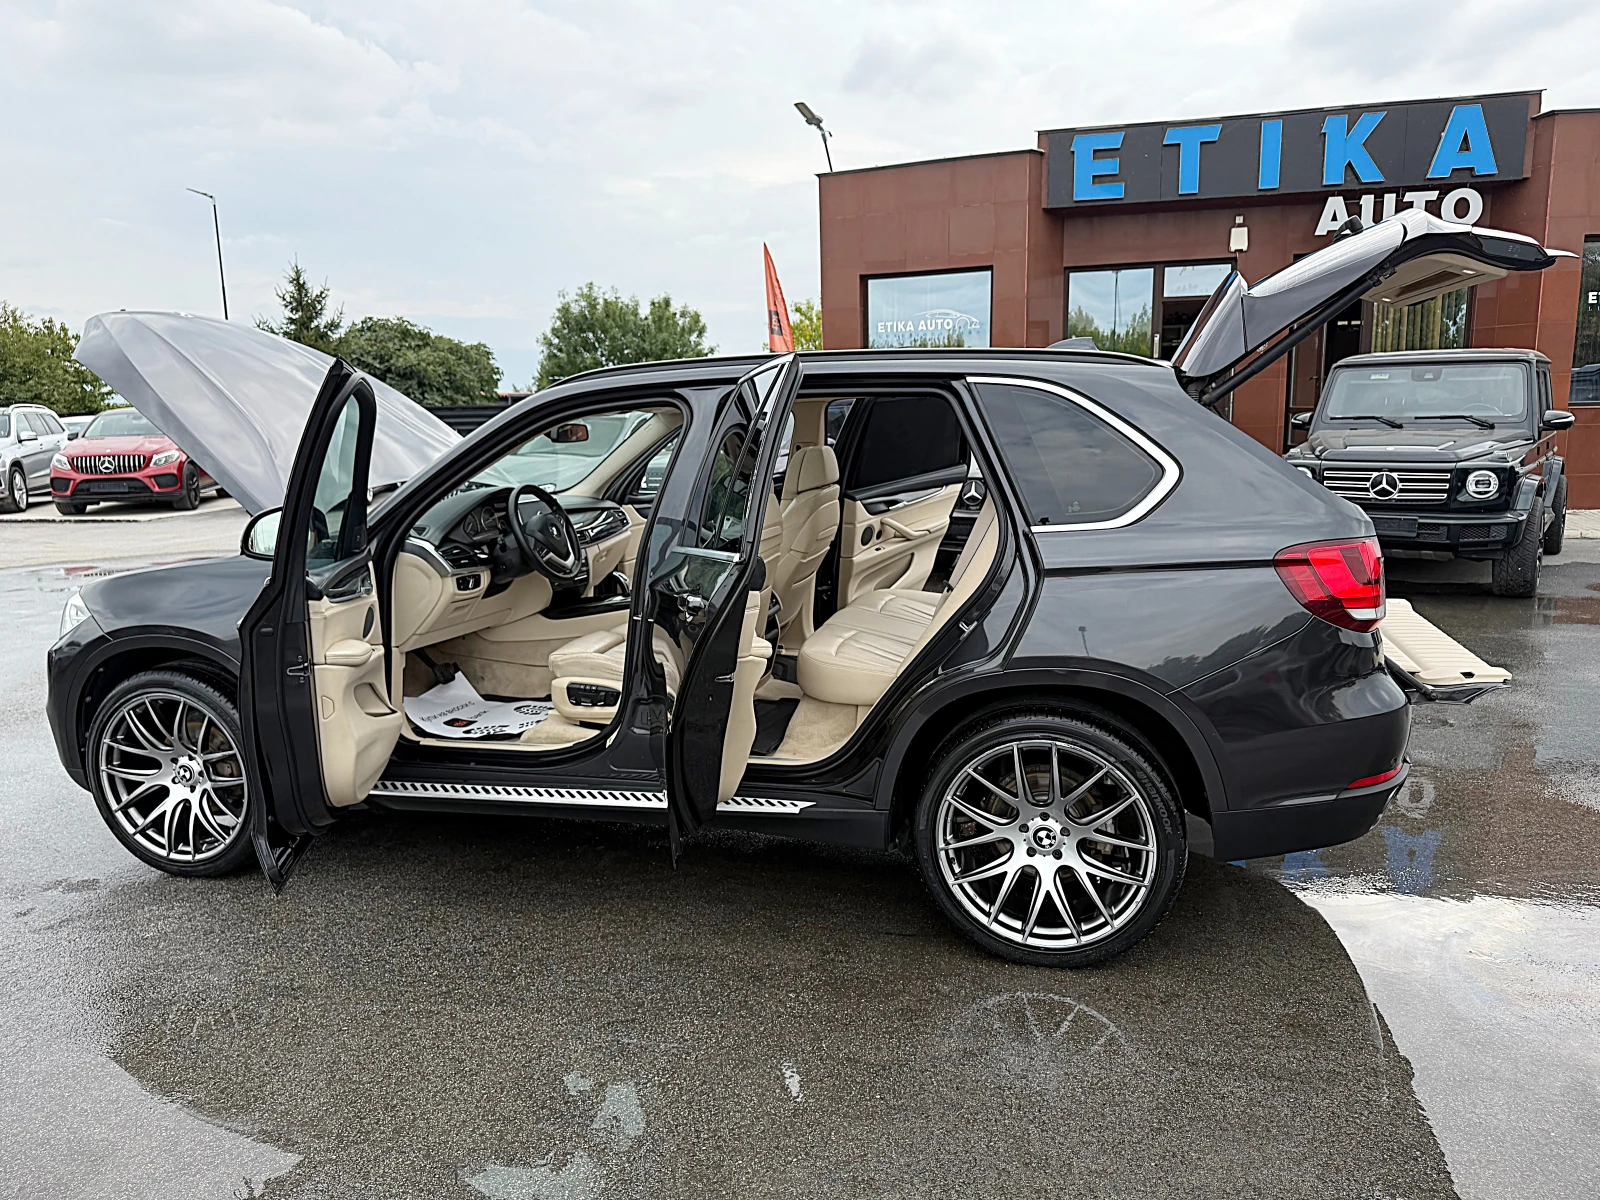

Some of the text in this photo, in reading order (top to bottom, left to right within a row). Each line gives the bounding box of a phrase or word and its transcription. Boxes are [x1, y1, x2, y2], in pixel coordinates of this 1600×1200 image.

[1070, 104, 1498, 200] ETIKA
[877, 319, 953, 333] ETIKA AUTO
